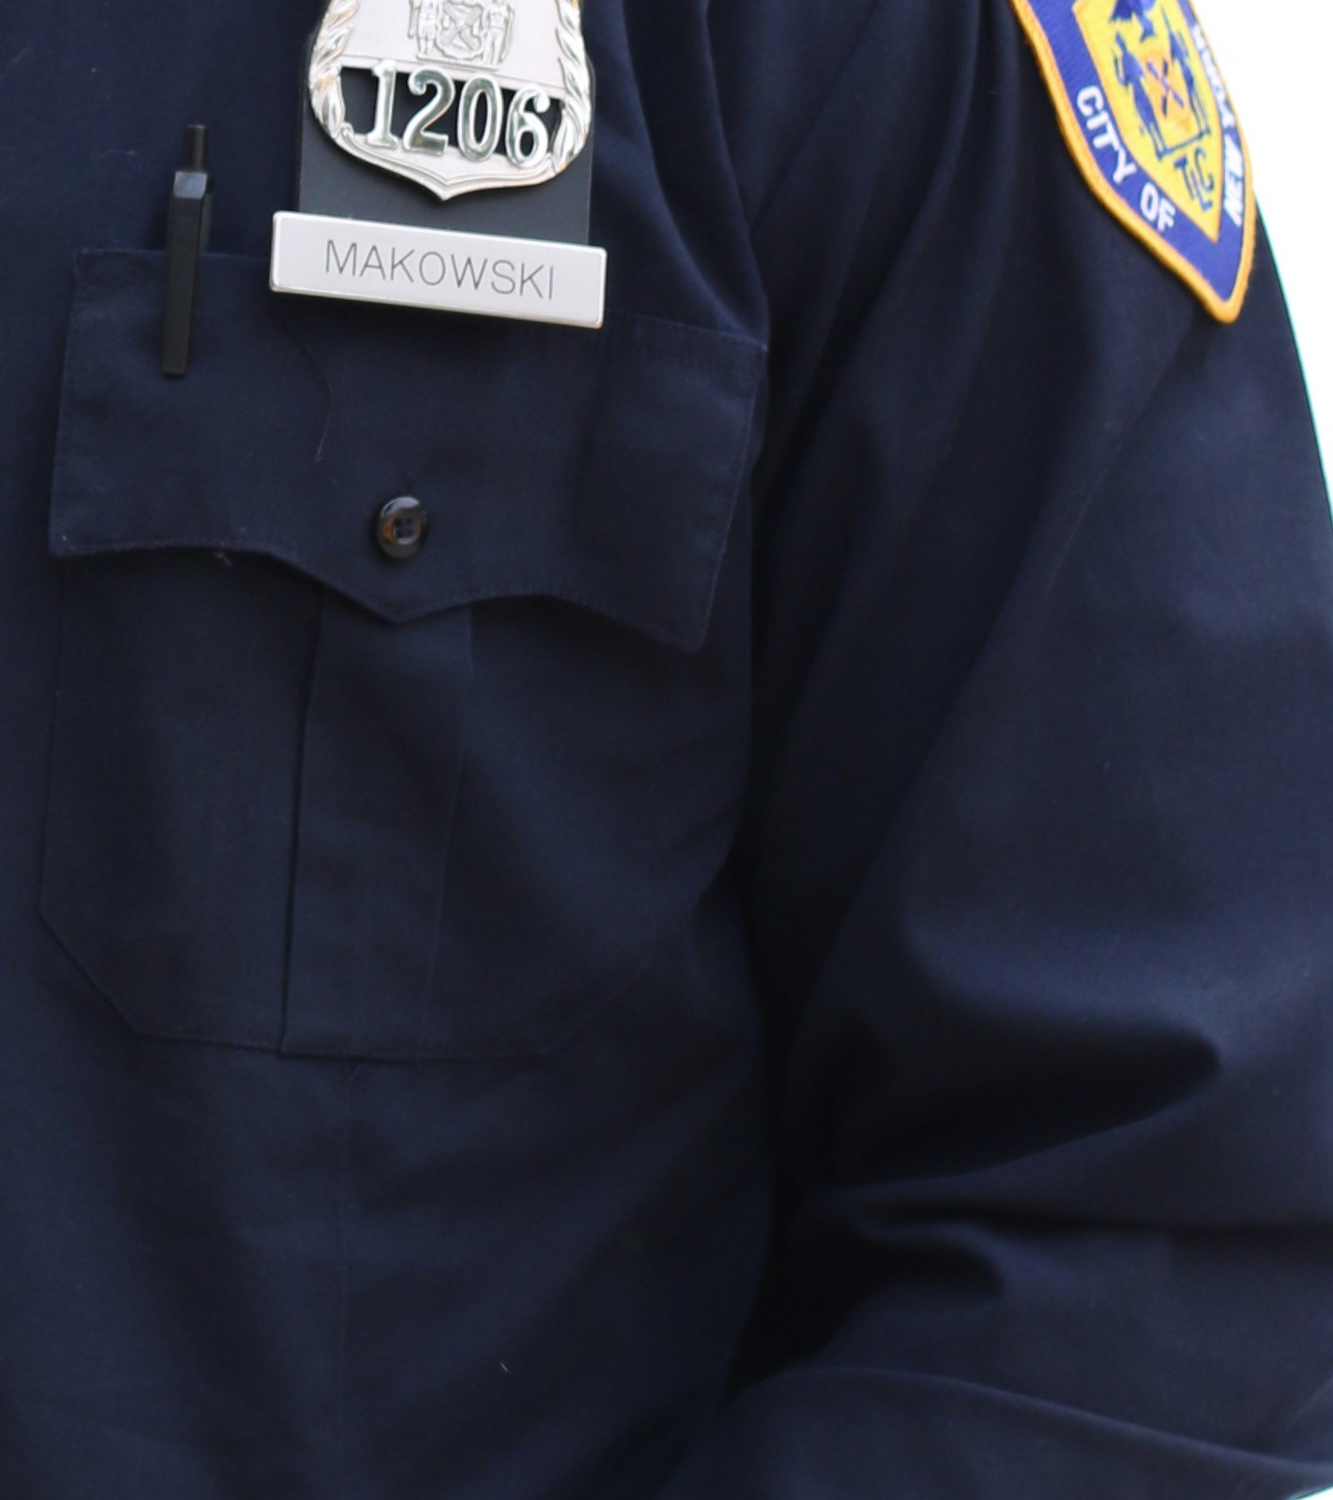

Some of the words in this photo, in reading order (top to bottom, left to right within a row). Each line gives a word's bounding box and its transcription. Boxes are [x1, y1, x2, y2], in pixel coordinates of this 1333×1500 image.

[366, 58, 552, 169] 1206
[1077, 85, 1137, 184] CITY
[1140, 182, 1176, 232] OF
[1174, 148, 1215, 213] TLC
[326, 239, 553, 300] MAKOWSKI
